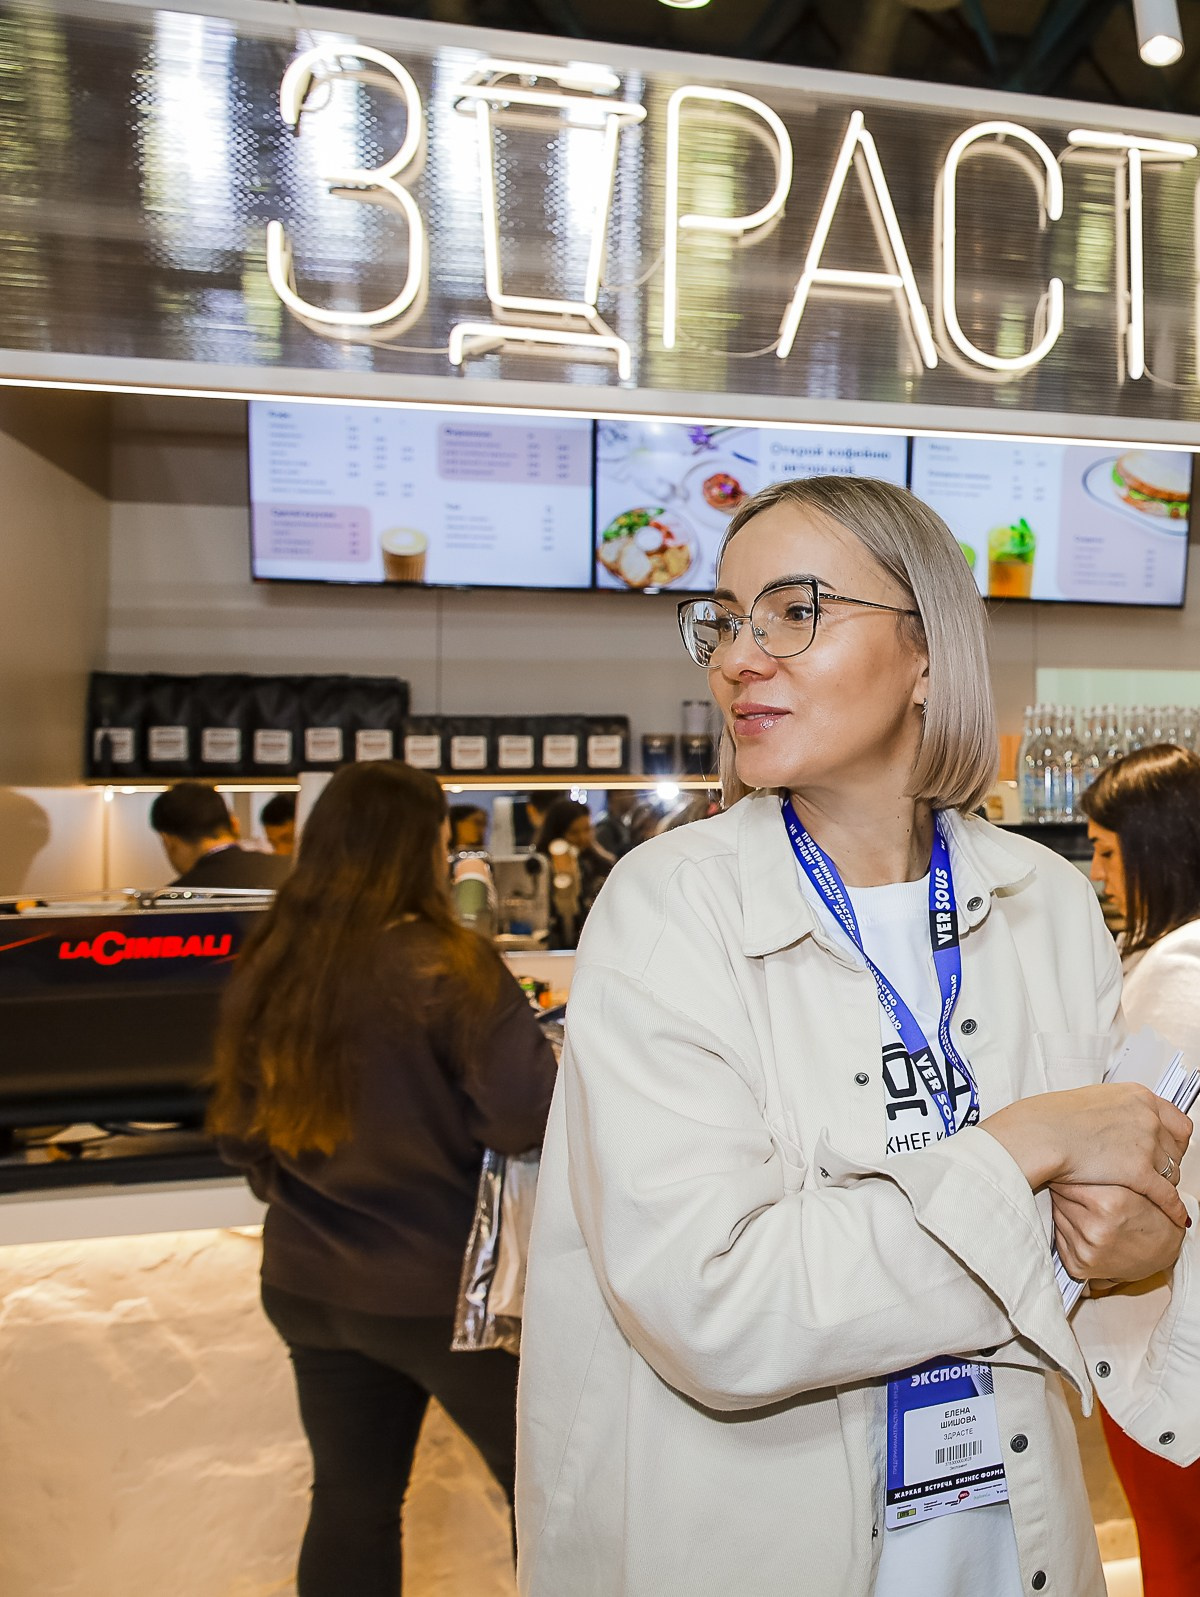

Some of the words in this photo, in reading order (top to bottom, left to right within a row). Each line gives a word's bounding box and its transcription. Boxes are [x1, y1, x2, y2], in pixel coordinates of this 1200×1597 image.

[795, 836, 816, 866] ВРЕДИТ
[812, 866, 836, 901] ВАШЕМУ
[801, 831, 856, 931] ПРЕДПРИНИМАТЕЛЬСТВО
[944, 1406, 971, 1418] ЕЛЕНА
[940, 1415, 977, 1429] ШИШОВА
[943, 1427, 974, 1440] ЗДРАСТЕ
[893, 1487, 922, 1500] ЖАРКАЯ
[924, 1479, 953, 1492] ВСТРЕЧА
